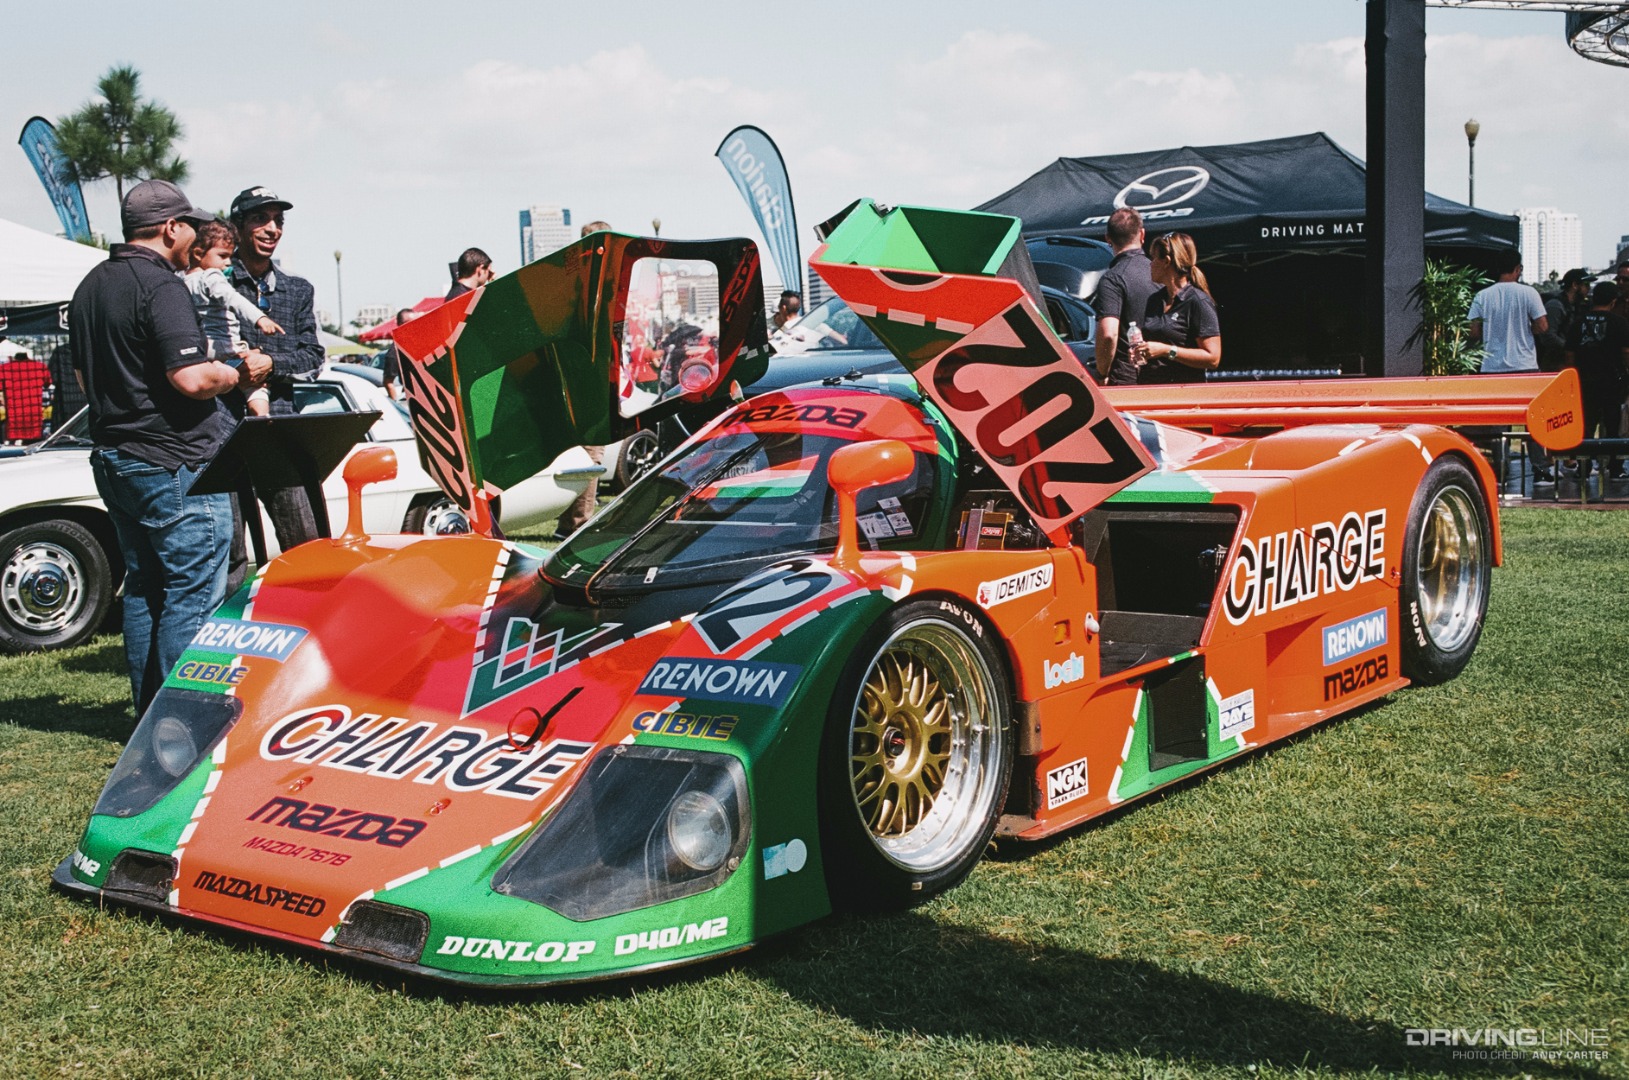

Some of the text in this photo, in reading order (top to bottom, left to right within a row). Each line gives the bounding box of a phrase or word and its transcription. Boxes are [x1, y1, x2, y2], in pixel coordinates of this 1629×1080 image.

[1261, 225, 1325, 238] DRIVING
[398, 347, 472, 511] 202
[713, 404, 868, 430] mazda
[932, 302, 1146, 520] 202
[1546, 410, 1574, 433] mazda
[995, 563, 1052, 601] IDEMITSU
[1223, 506, 1387, 626] CHARGE
[195, 621, 297, 655] RENOWN
[940, 601, 983, 638] AVON
[1326, 614, 1386, 660] RENOWN
[1409, 600, 1427, 648] AVON
[641, 662, 788, 699] RENOWN
[1324, 654, 1389, 702] mazda
[259, 704, 598, 801] CHARGE
[1049, 761, 1086, 799] NGK
[246, 796, 428, 849] mazda
[243, 836, 301, 861] MAZDA
[193, 870, 327, 918] MAZDASPEED
[437, 916, 730, 963] DUNLOP D40/M2
